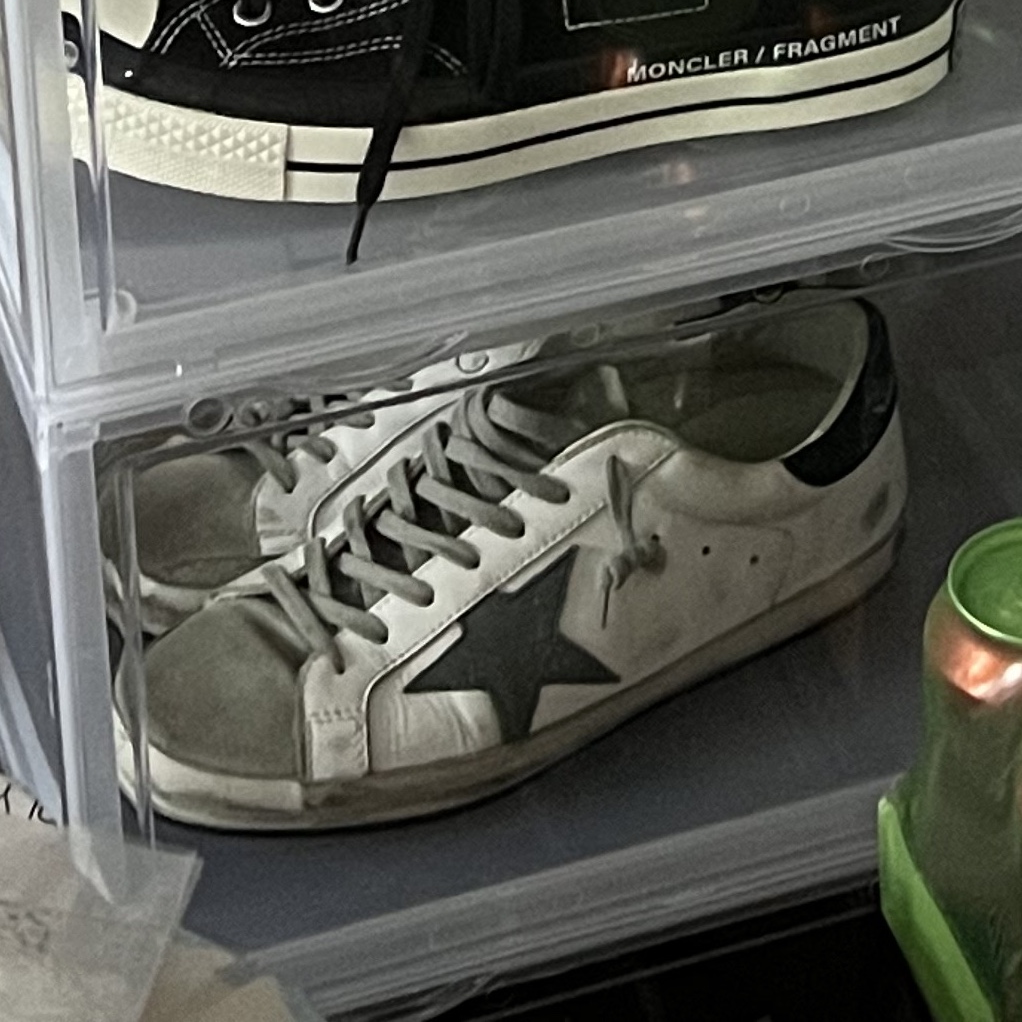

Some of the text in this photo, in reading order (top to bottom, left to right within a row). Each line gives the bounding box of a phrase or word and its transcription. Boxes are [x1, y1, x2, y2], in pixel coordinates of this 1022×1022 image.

[627, 15, 902, 83] MONCLER / FRAGMENT
